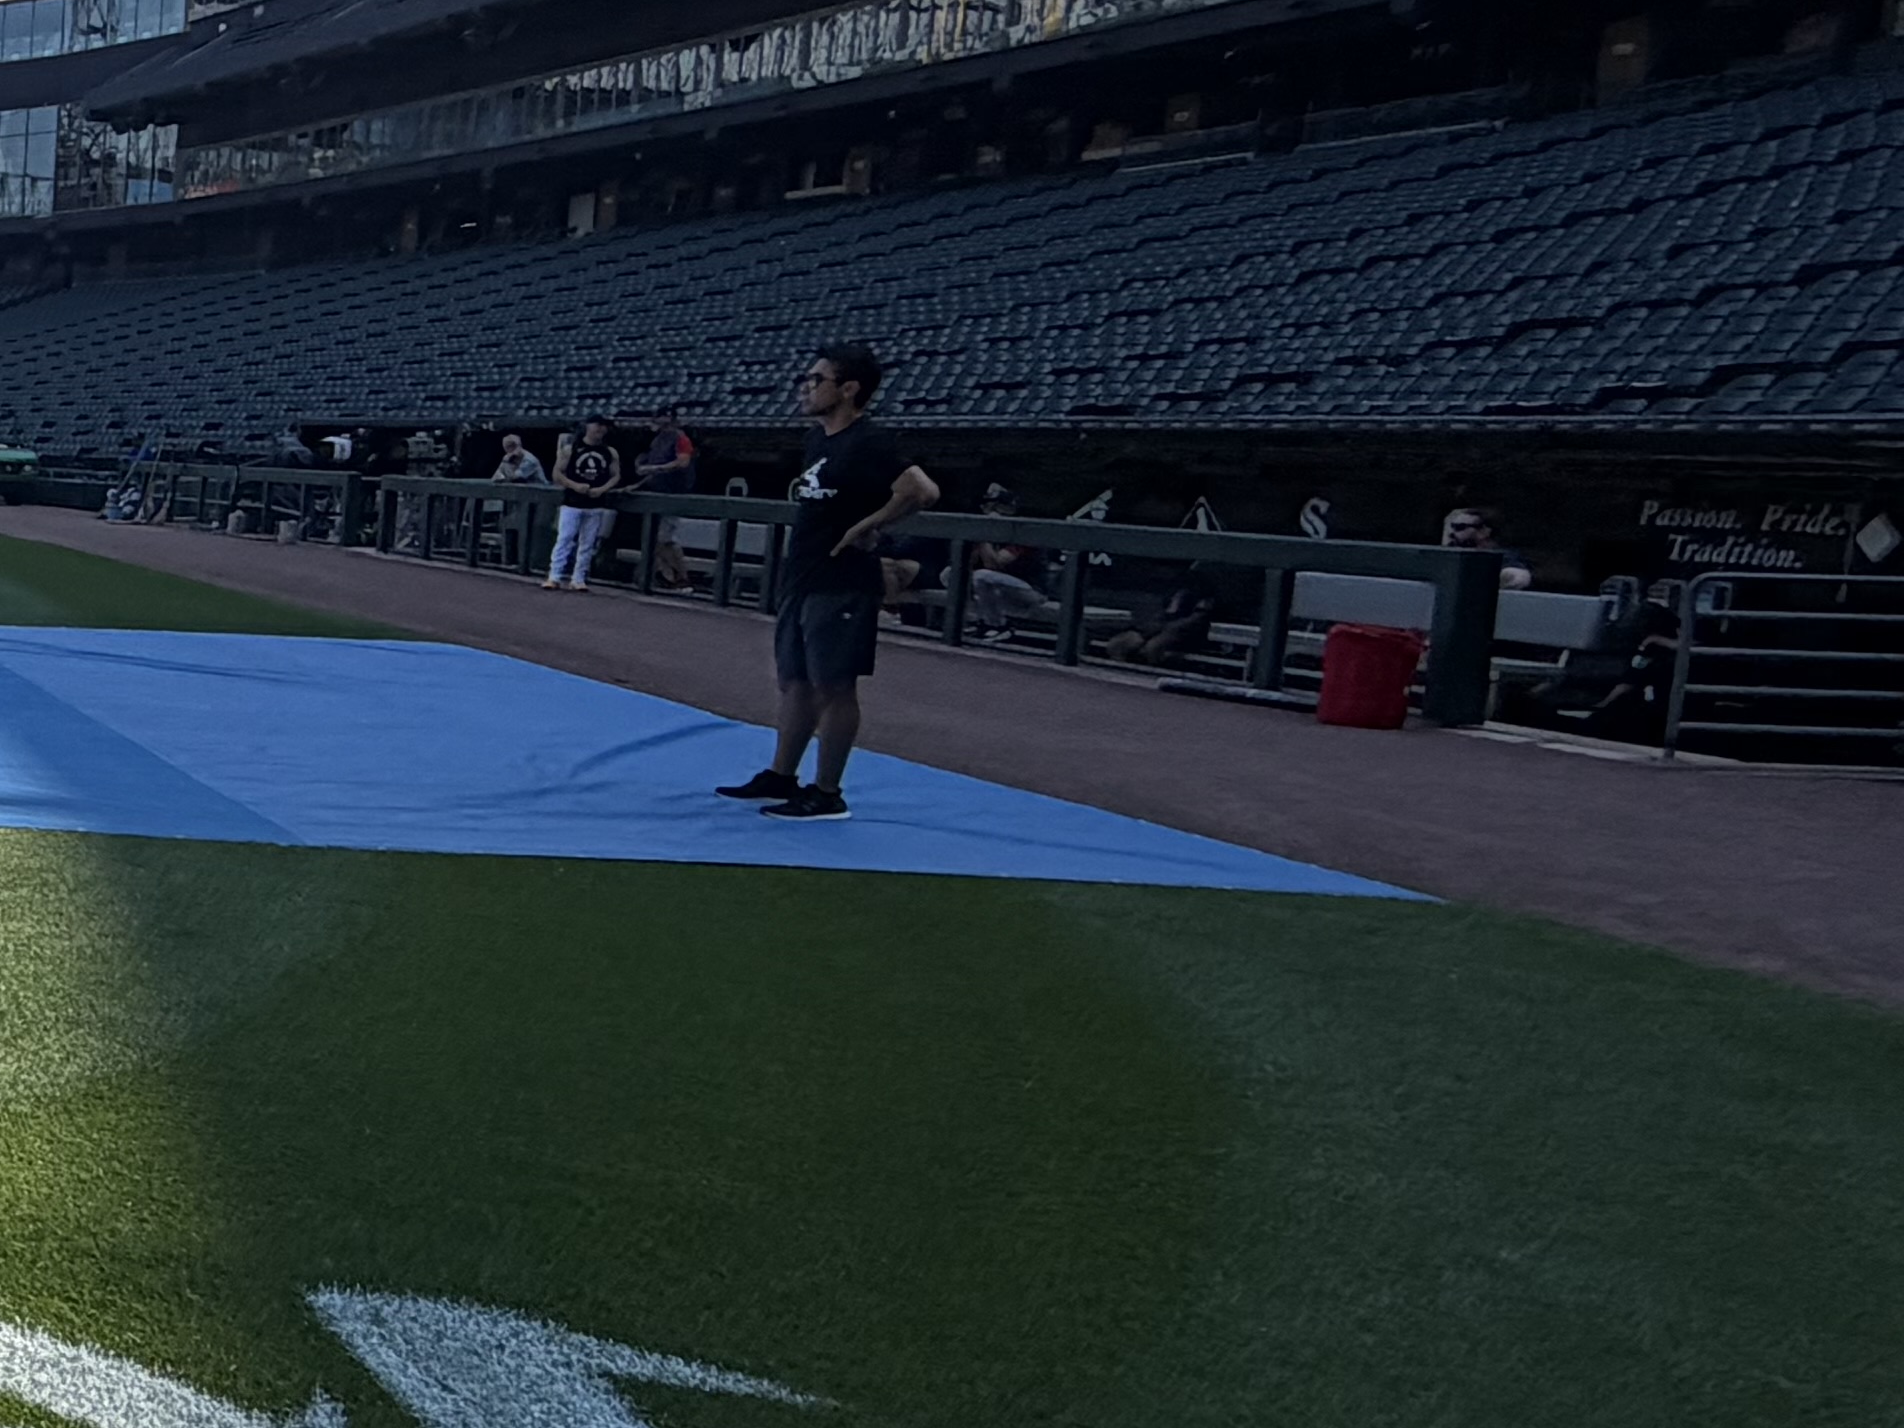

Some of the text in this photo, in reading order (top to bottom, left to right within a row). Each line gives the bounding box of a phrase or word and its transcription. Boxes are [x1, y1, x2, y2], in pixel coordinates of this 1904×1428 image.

[1639, 499, 1847, 536] Passion. Pride.
[1667, 533, 1803, 568] Tradition.
